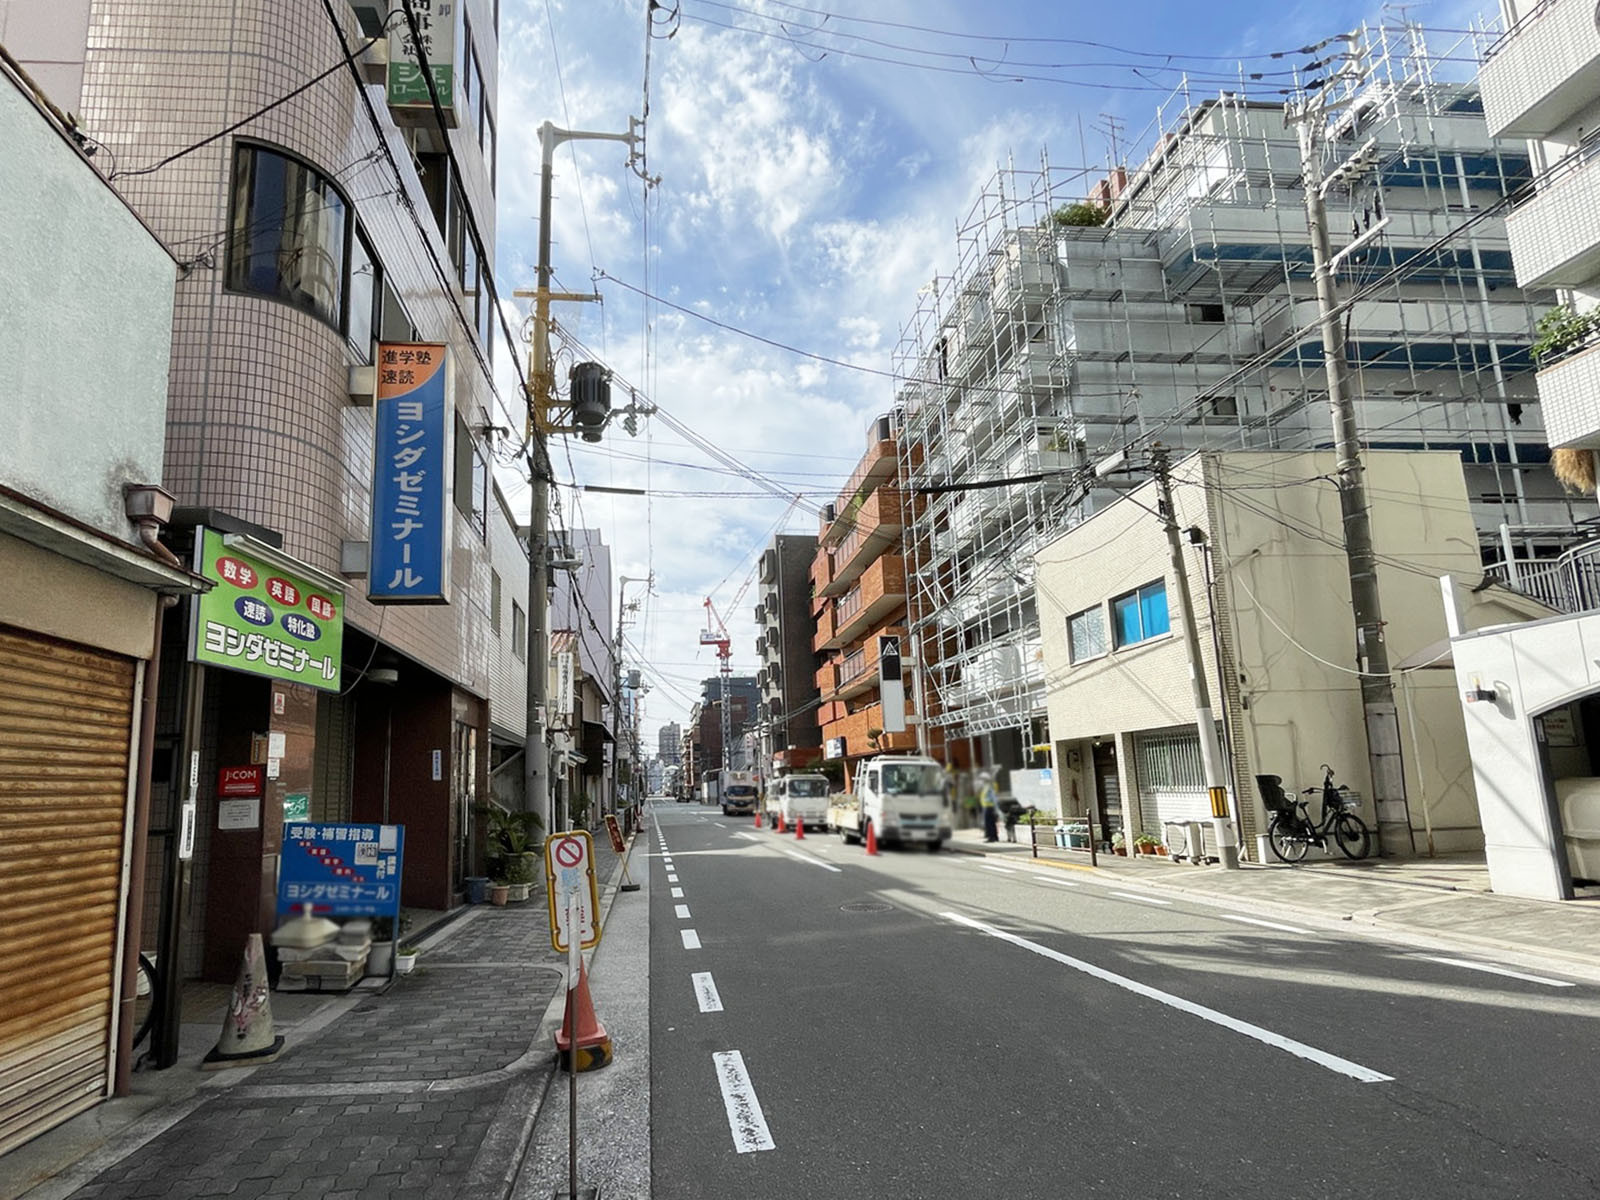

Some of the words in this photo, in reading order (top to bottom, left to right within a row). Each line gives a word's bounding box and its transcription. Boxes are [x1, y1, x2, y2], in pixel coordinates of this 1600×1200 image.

[382, 350, 431, 366] 進学塾
[381, 370, 415, 386] 速読
[388, 401, 426, 590] ヨシダゼミナール
[223, 559, 252, 585] 数学
[271, 580, 296, 603] 英語
[243, 600, 267, 623] 速読
[287, 616, 316, 640] 特化塾
[205, 620, 337, 680] ヨシダゼミナール
[290, 826, 375, 841] 受験・補習指導
[287, 884, 390, 900] ヨシダゼミナール
